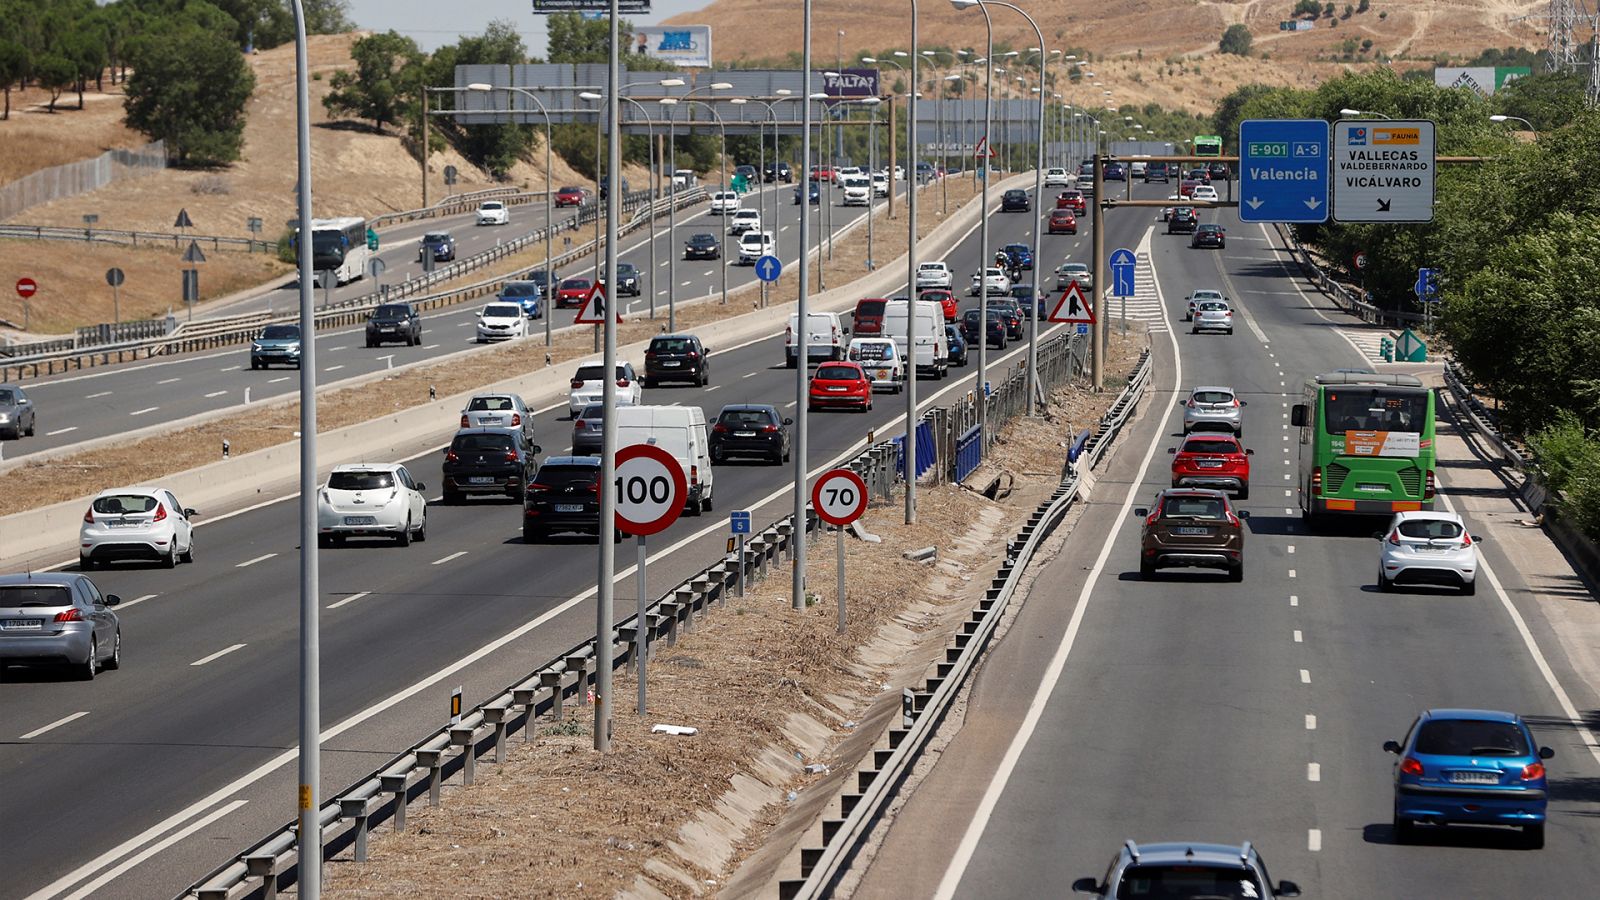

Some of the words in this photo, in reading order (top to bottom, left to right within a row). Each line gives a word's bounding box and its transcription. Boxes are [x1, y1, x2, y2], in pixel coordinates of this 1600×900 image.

[1250, 144, 1286, 155] E-901
[1295, 144, 1319, 155] A-3
[1349, 150, 1418, 161] VALLECAS
[1340, 162, 1428, 170] VALDEBERNARDO
[1250, 167, 1318, 180] Valencia
[1346, 174, 1422, 188] VICÁLVARO
[615, 476, 670, 504] 100
[826, 488, 854, 506] 70
[737, 522, 743, 530] 5
